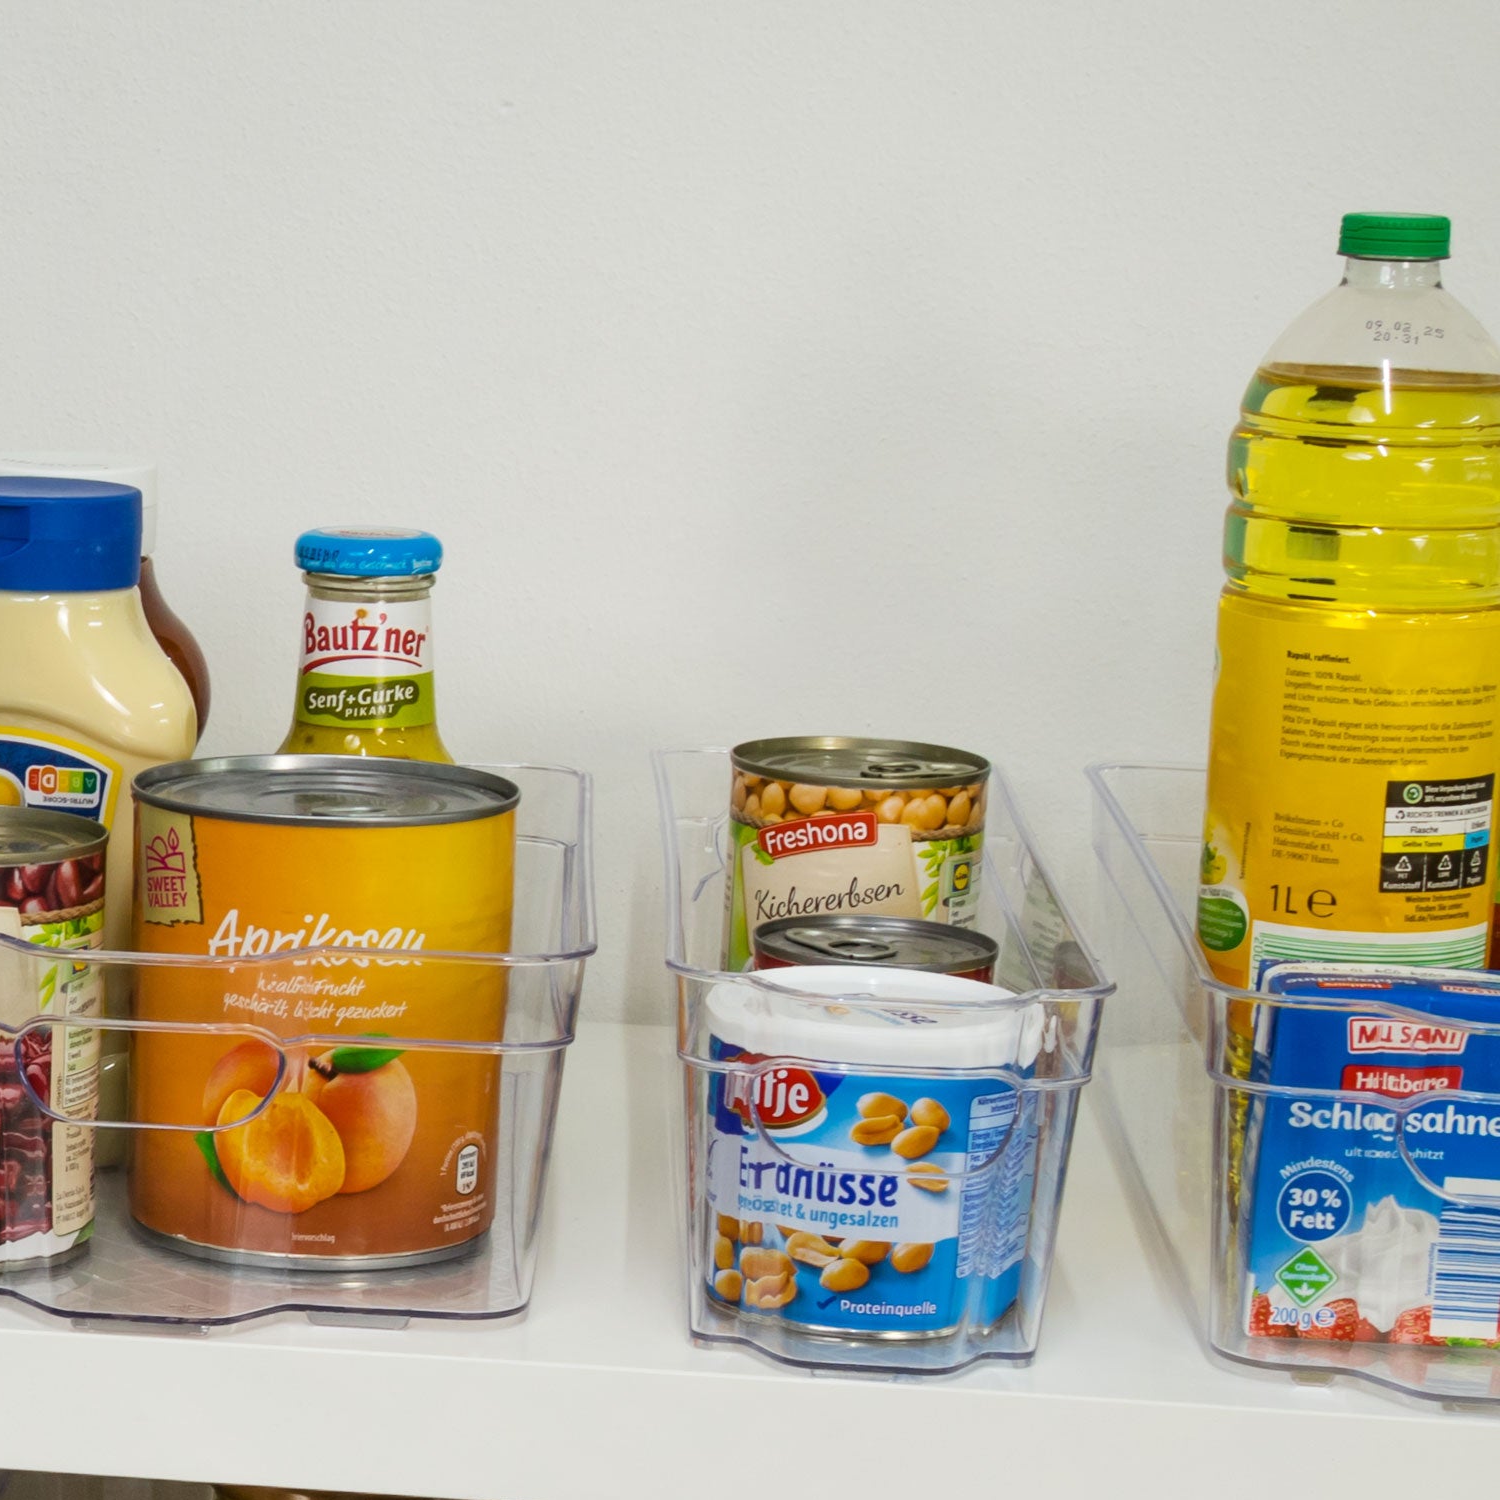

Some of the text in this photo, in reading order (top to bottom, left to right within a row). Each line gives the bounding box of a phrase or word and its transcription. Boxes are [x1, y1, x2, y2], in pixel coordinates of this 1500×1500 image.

[304, 611, 426, 658] Bautz'ner
[308, 685, 415, 713] Senf+Gurke
[345, 703, 395, 718] PIKANT
[764, 820, 869, 855] Freshona
[1410, 826, 1439, 834] Flasche
[146, 875, 187, 892] SWEET
[146, 892, 188, 908] VALLEY
[754, 876, 906, 921] Kichererbsen
[334, 1000, 408, 1027] gezuckert
[1279, 1155, 1356, 1183] Mindestens
[1288, 1187, 1342, 1208] 30 %
[809, 1208, 899, 1230] ungesalzen
[1289, 1210, 1336, 1230] Fett
[839, 1299, 938, 1318] Proteinquelle
[1271, 1306, 1312, 1330] 200 g
